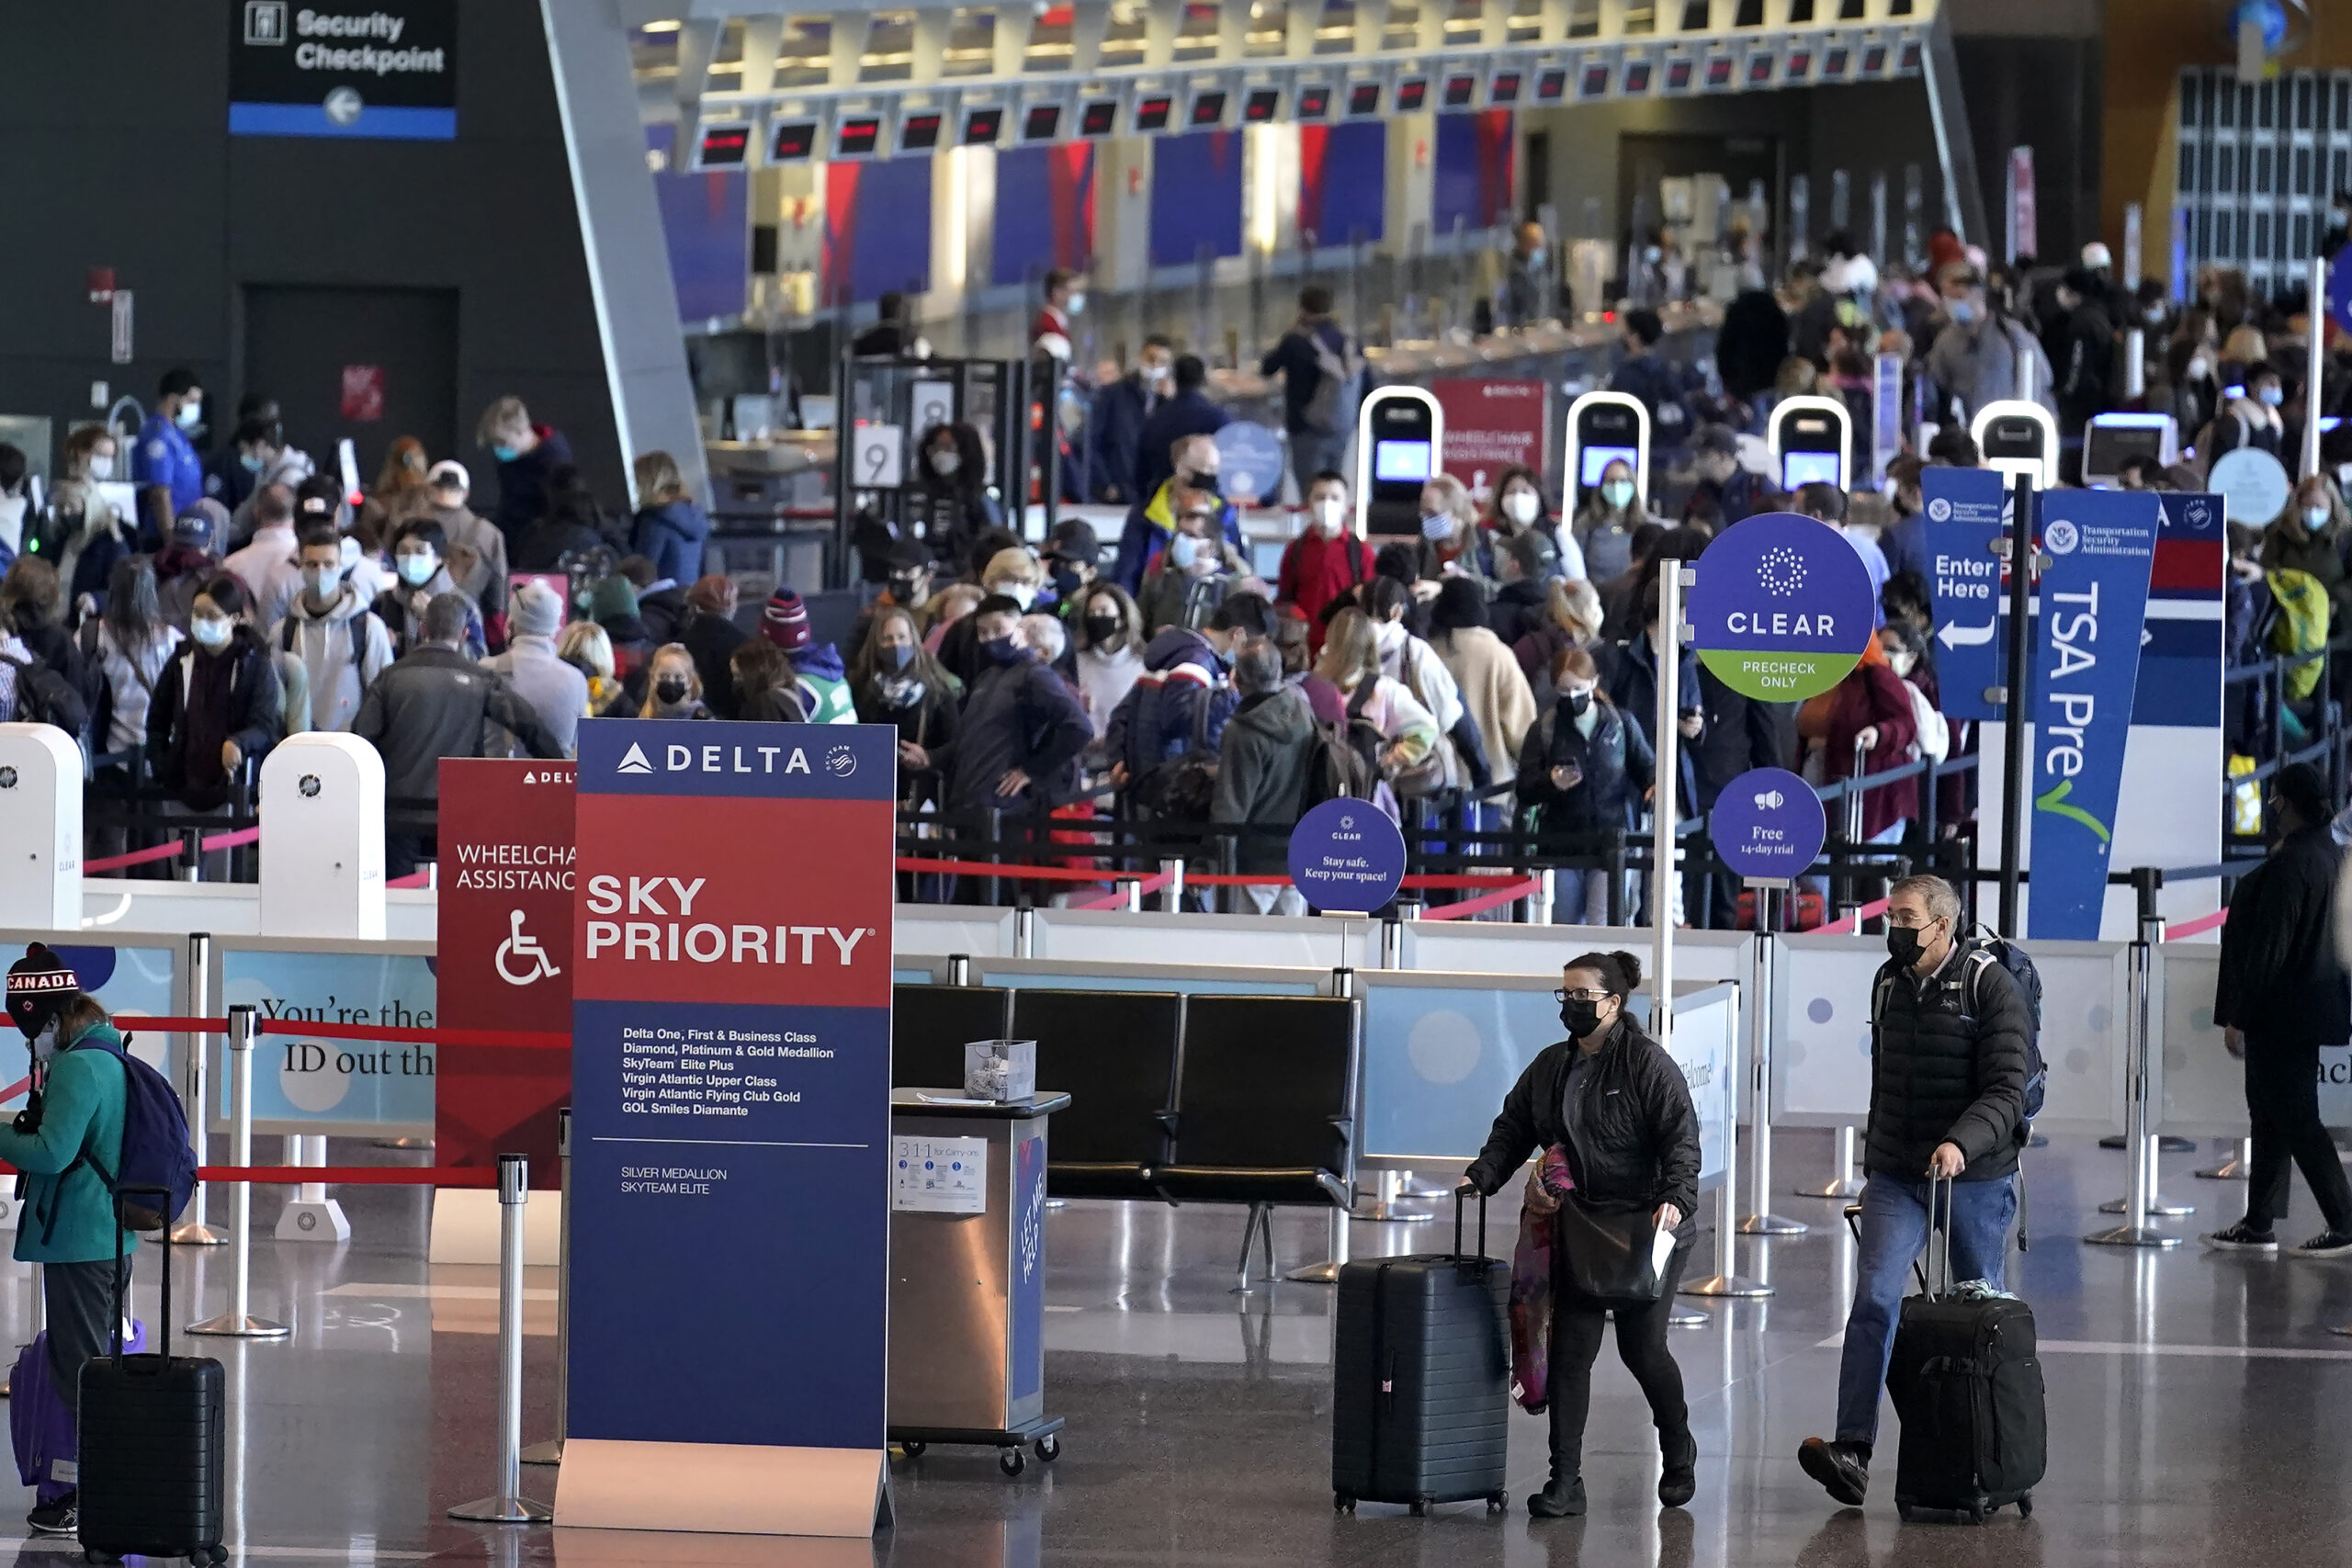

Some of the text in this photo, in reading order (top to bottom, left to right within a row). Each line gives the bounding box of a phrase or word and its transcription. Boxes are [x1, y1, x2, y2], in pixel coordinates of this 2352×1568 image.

[296, 9, 404, 43] Security
[295, 42, 445, 76] Checkpoint
[865, 444, 889, 481] 9
[2081, 525, 2149, 537] Transportation
[2082, 536, 2120, 546] Security
[2081, 544, 2150, 556] Administration
[1936, 555, 1994, 577] Enter
[1938, 577, 1989, 599] Here
[1727, 612, 1834, 637] CLEAR
[1742, 661, 1815, 674] PRECHECK
[1761, 676, 1797, 688] ONLY
[2046, 581, 2098, 776] TSA Pre
[667, 745, 811, 773] DELTA
[541, 772, 577, 784] DEL
[1332, 832, 1361, 840] CLEAR
[1752, 826, 1783, 840] Free
[1741, 843, 1793, 856] 14-day trial
[1323, 856, 1369, 868] Stay safe.
[1305, 868, 1386, 883] Keep your space!
[586, 874, 707, 916] SKY
[7, 974, 77, 989] CANADA
[379, 999, 434, 1029] the
[623, 1028, 653, 1039] Delta
[688, 1029, 714, 1041] First
[717, 1030, 726, 1041] &
[729, 1031, 781, 1042] Business
[784, 1032, 817, 1043] Class
[623, 1043, 678, 1055] Diamond,
[681, 1043, 731, 1055] Platinum
[735, 1045, 744, 1056] &
[747, 1045, 774, 1056] Gold
[284, 1043, 325, 1072] ID
[336, 1049, 391, 1074] out
[681, 1059, 706, 1070] Elite
[709, 1060, 734, 1071] Plus
[622, 1073, 777, 1088] Virgin Atlantic Upper Class
[622, 1088, 801, 1102] Virgin Atlantic Flying Club Gold
[622, 1102, 749, 1116] GOL Smiles Diamante
[621, 1167, 727, 1179] SILVER MEDALLION
[621, 1181, 709, 1194] SKYTEAM ELITE
[1021, 1172, 1042, 1255] LET ME
[1023, 1223, 1039, 1284] HELP
